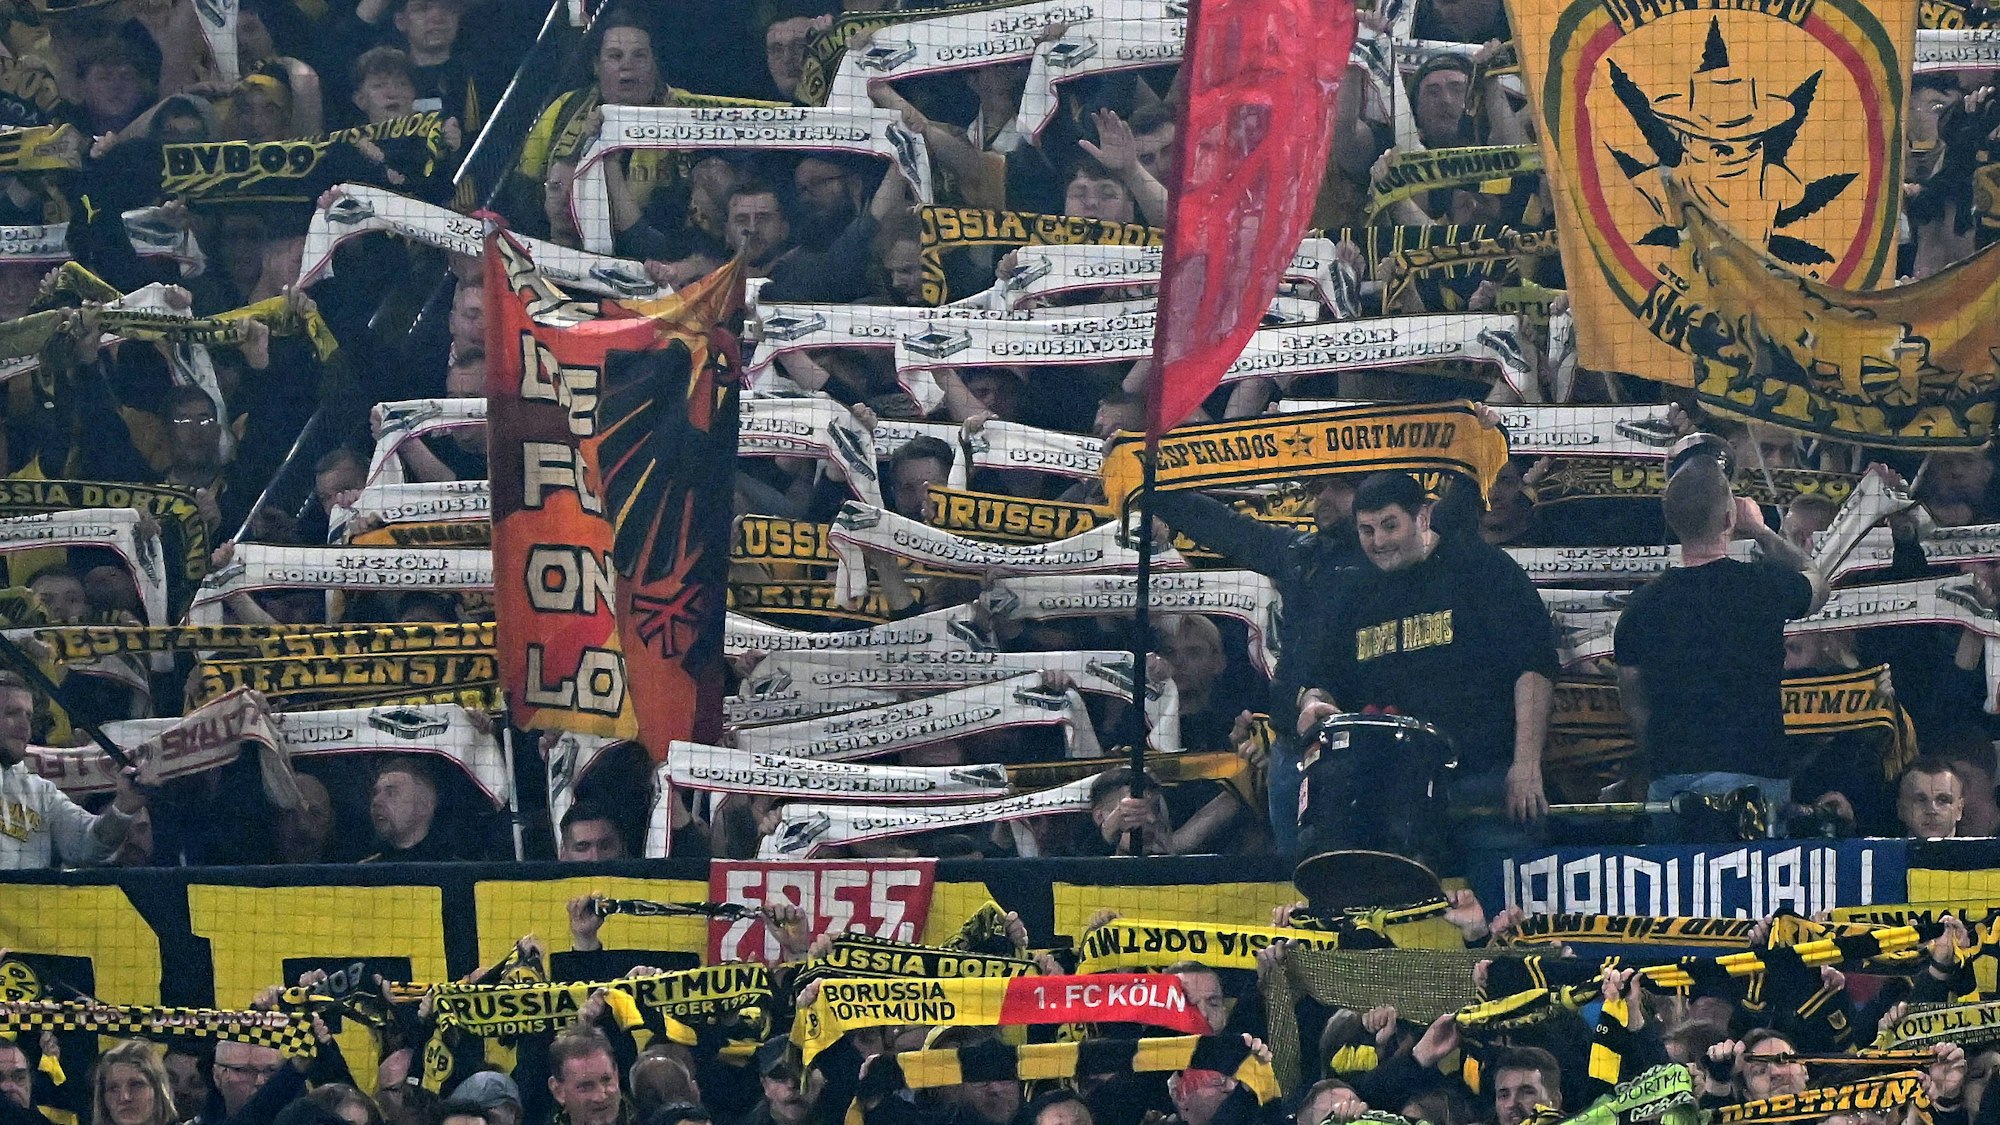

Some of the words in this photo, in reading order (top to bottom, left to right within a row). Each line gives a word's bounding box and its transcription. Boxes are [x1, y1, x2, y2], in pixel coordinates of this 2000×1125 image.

[743, 127, 867, 141] DORTMUND
[995, 339, 1096, 356] BORUSSIA
[1335, 342, 1456, 362] DORTMUND
[1325, 421, 1456, 452] DORTMUND
[273, 570, 386, 585] BORUSSIA
[805, 775, 931, 792] DORTMUND
[823, 982, 946, 1003] BORUSSIA
[1065, 984, 1102, 1008] FC
[1107, 977, 1186, 1013] KÖLN
[1595, 1024, 1609, 1035] 09
